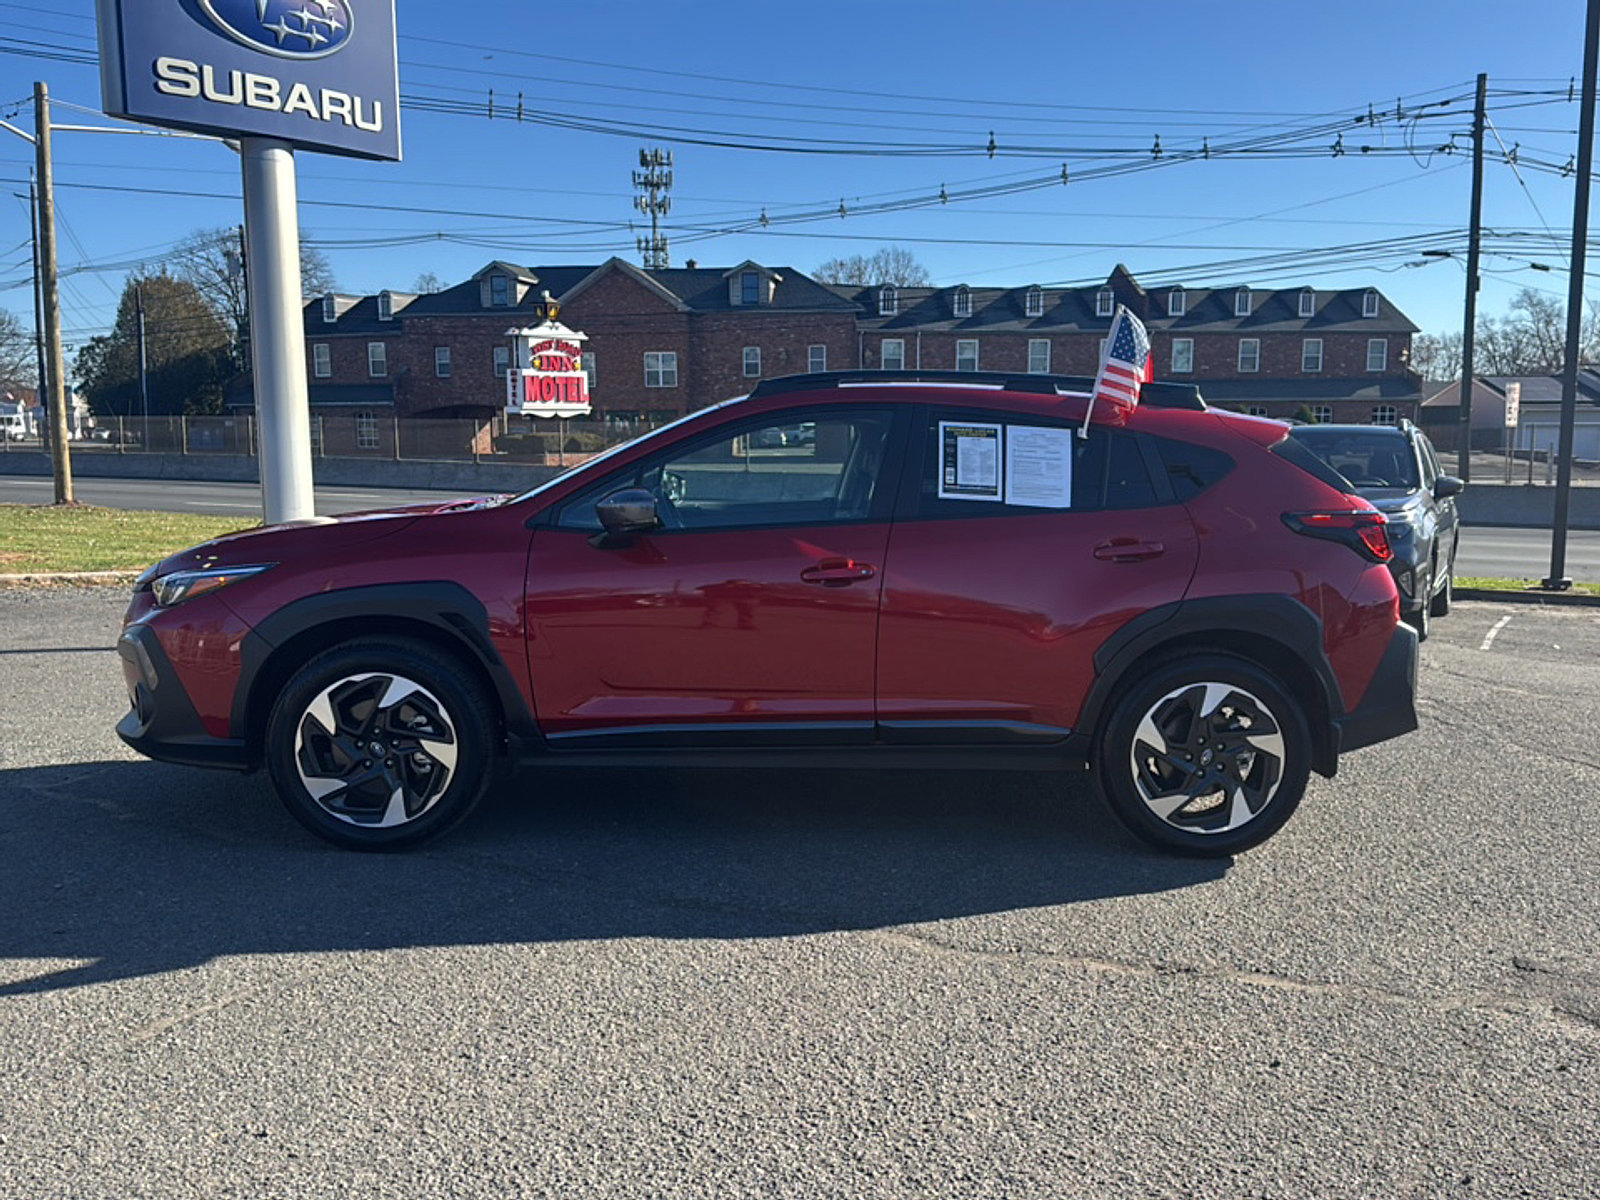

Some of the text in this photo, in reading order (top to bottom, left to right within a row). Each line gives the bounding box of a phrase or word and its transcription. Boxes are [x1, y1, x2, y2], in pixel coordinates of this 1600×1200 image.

[155, 56, 383, 133] SUBARU
[540, 355, 575, 371] INN
[524, 375, 591, 403] MOTEL
